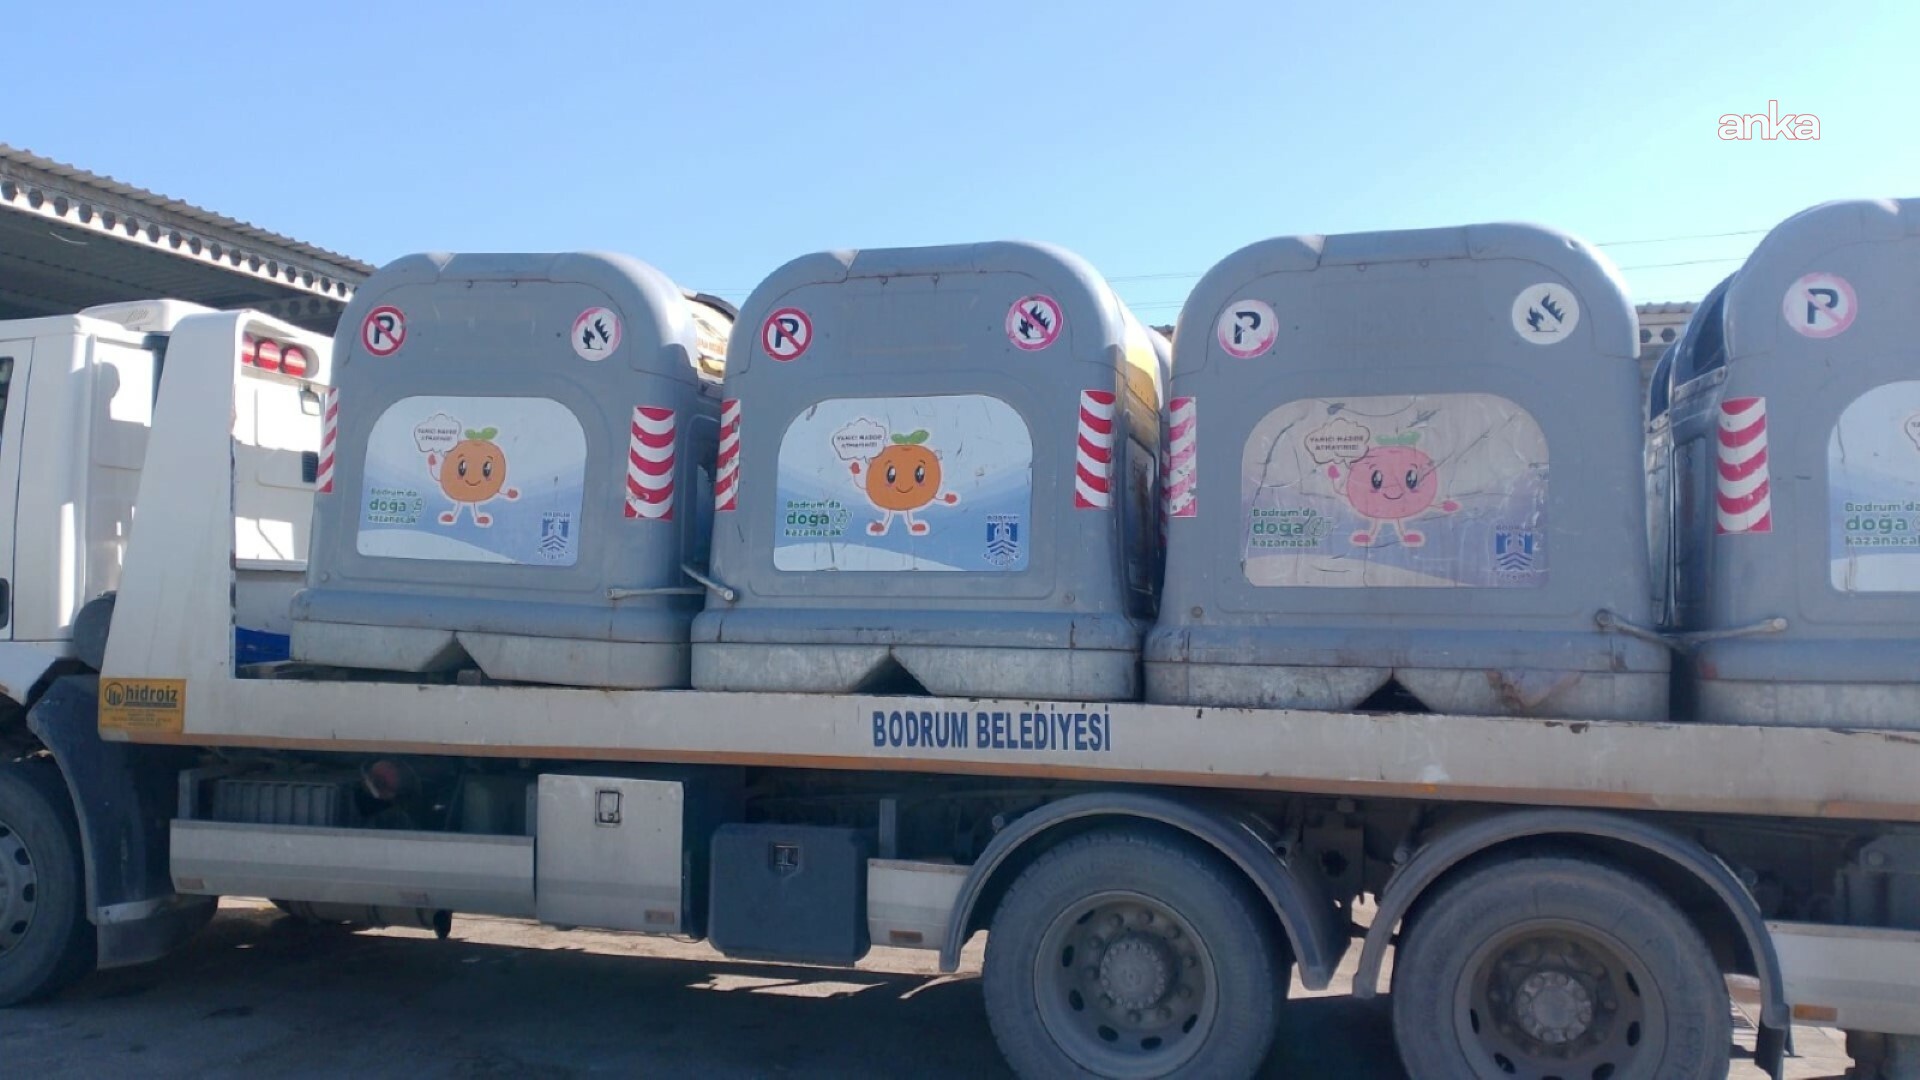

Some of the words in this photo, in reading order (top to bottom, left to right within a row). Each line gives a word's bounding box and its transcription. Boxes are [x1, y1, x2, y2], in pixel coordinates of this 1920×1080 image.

[369, 498, 406, 513] doğa
[787, 500, 841, 509] Bodrum'da
[1253, 508, 1317, 517] Bodrum'da
[786, 510, 830, 527] doğa
[1846, 514, 1908, 535] doğa
[785, 528, 841, 537] kazanacak
[1253, 519, 1304, 537] doğa
[1252, 537, 1318, 547] kazanacak
[125, 684, 178, 702] hidroiz
[872, 710, 969, 748] BODRUM
[976, 703, 1112, 751] BELEDİYESİ
